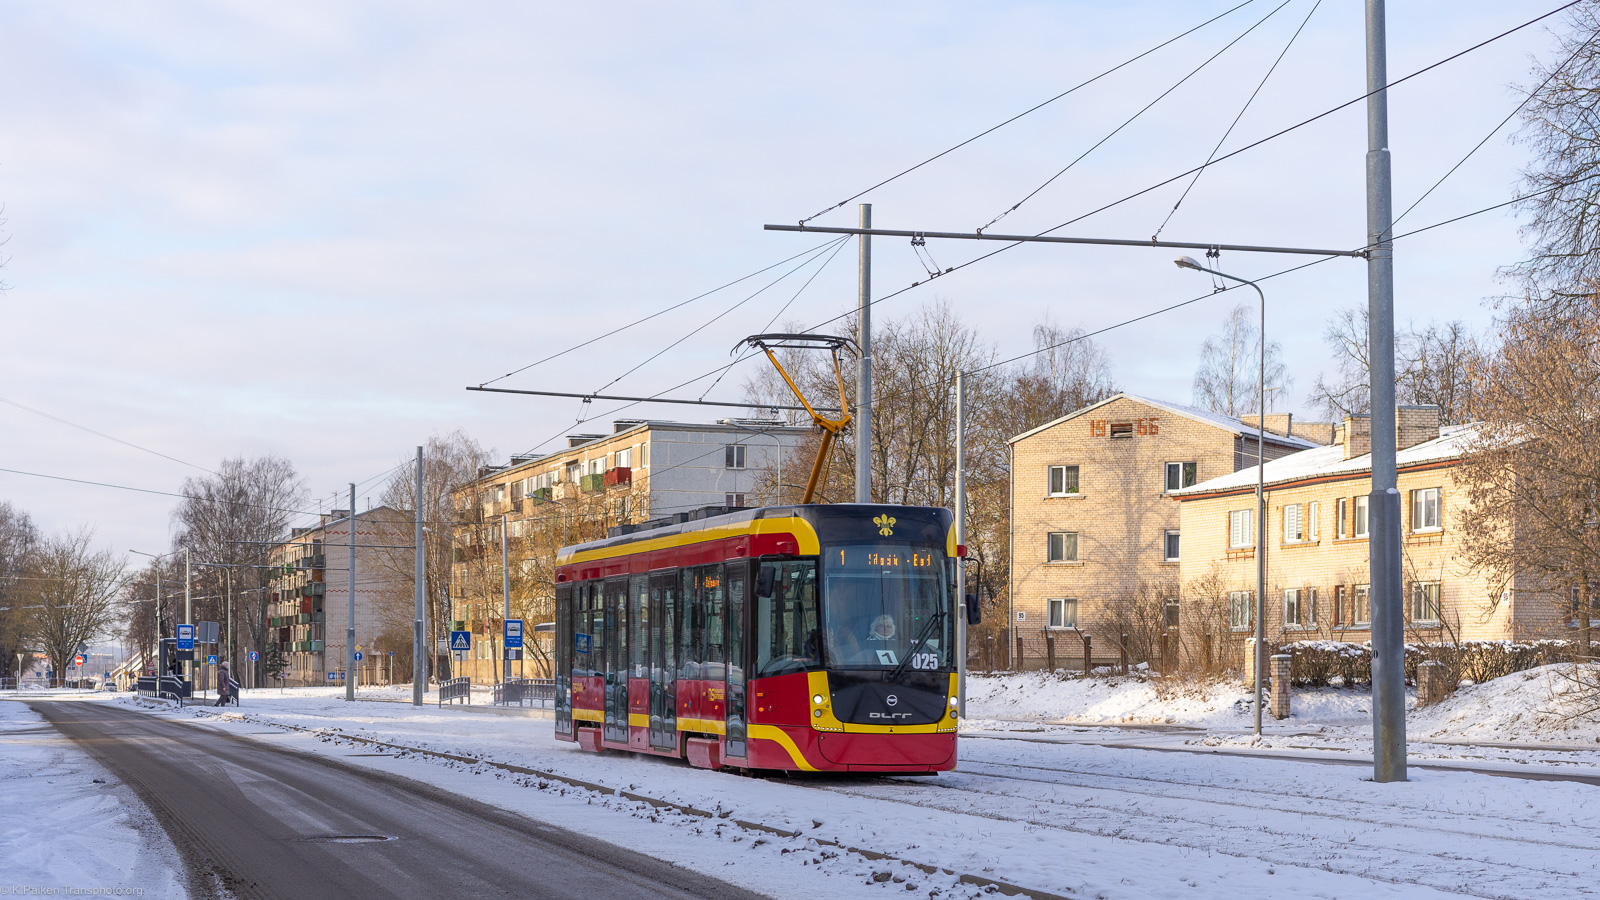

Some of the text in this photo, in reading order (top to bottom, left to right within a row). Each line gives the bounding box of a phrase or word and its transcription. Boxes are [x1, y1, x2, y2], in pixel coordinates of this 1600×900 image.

[1090, 418, 1159, 437] 19 66
[840, 549, 845, 565] 1
[912, 653, 939, 670] 025
